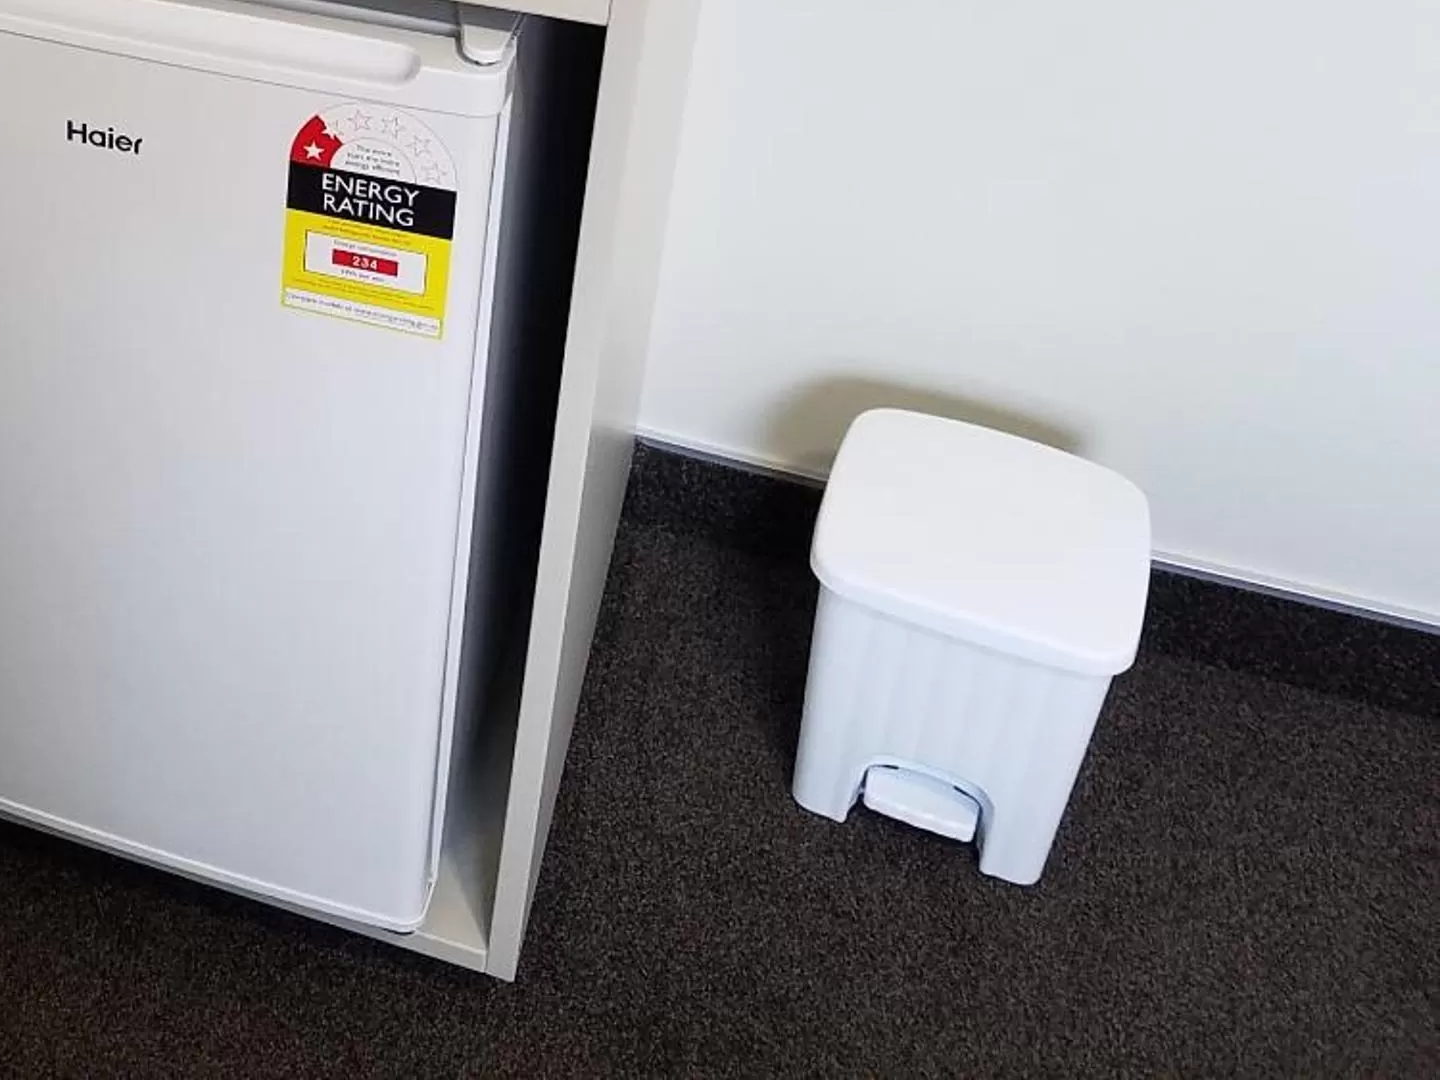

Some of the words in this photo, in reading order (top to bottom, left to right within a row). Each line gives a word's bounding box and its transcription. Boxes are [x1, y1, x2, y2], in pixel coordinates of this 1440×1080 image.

[67, 120, 143, 155] Haier
[322, 173, 419, 207] ENERGY
[323, 193, 414, 227] RATING
[352, 256, 378, 270] 234
